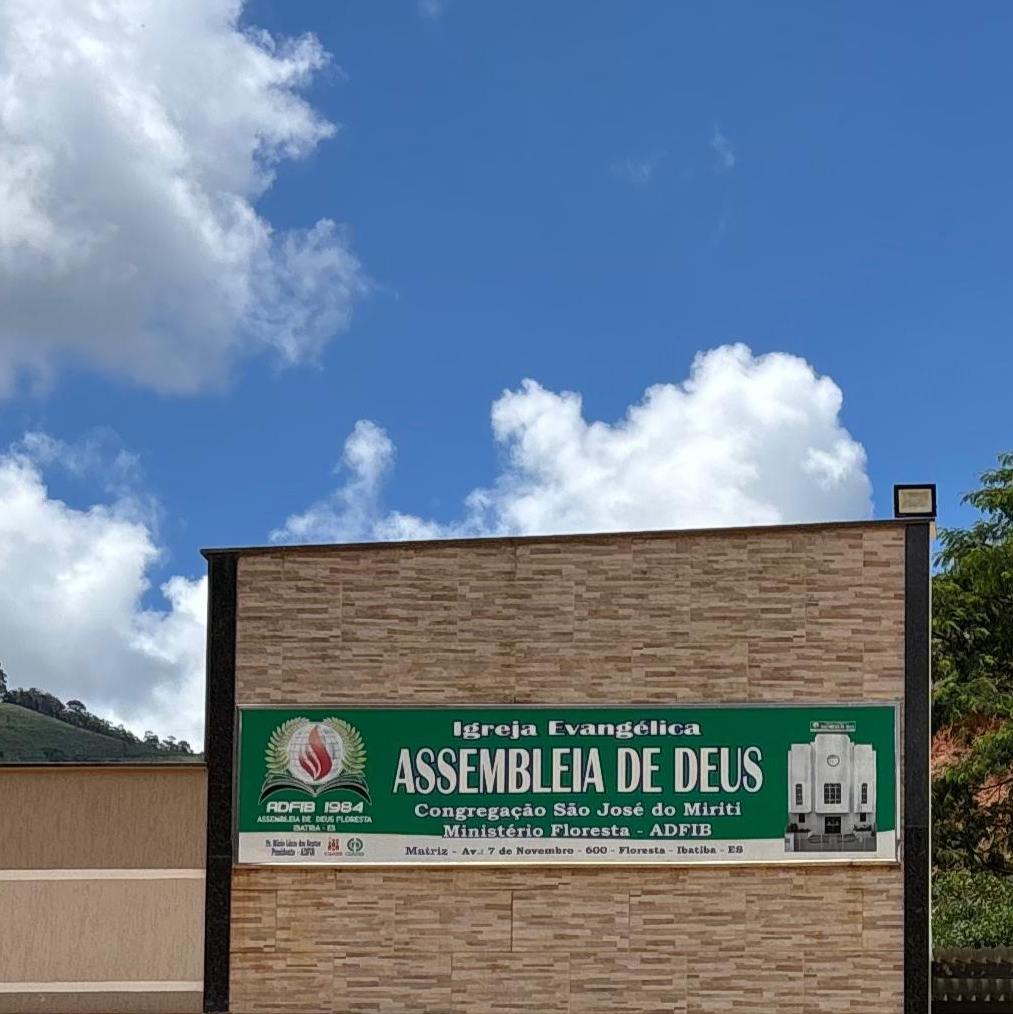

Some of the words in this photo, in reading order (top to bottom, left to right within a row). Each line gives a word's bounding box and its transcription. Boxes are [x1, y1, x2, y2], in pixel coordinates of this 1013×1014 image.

[453, 721, 537, 739] Igreja
[548, 720, 701, 739] Evangélica
[393, 747, 604, 794] ASSEMBLEIA
[617, 747, 663, 793] DE
[674, 746, 763, 793] DEUS
[266, 801, 315, 813] ADFIB
[324, 801, 364, 813] 1984
[414, 803, 546, 821] Congregação
[553, 802, 590, 817] São
[597, 802, 644, 817] José
[651, 802, 676, 816] do
[683, 802, 741, 816] Miriti
[315, 815, 334, 823] DEUS
[336, 815, 373, 823] FLORESTA
[443, 823, 544, 838] Ministério
[551, 823, 630, 837] Floresta
[649, 823, 712, 837] ADFIB
[405, 846, 449, 856] Matriz
[488, 847, 495, 855] 7
[499, 847, 512, 855] de
[516, 846, 574, 855] Novembro
[586, 846, 607, 854] 600
[619, 846, 666, 854] Floresta
[677, 846, 716, 854] Ibatiba
[728, 845, 744, 854] ES
